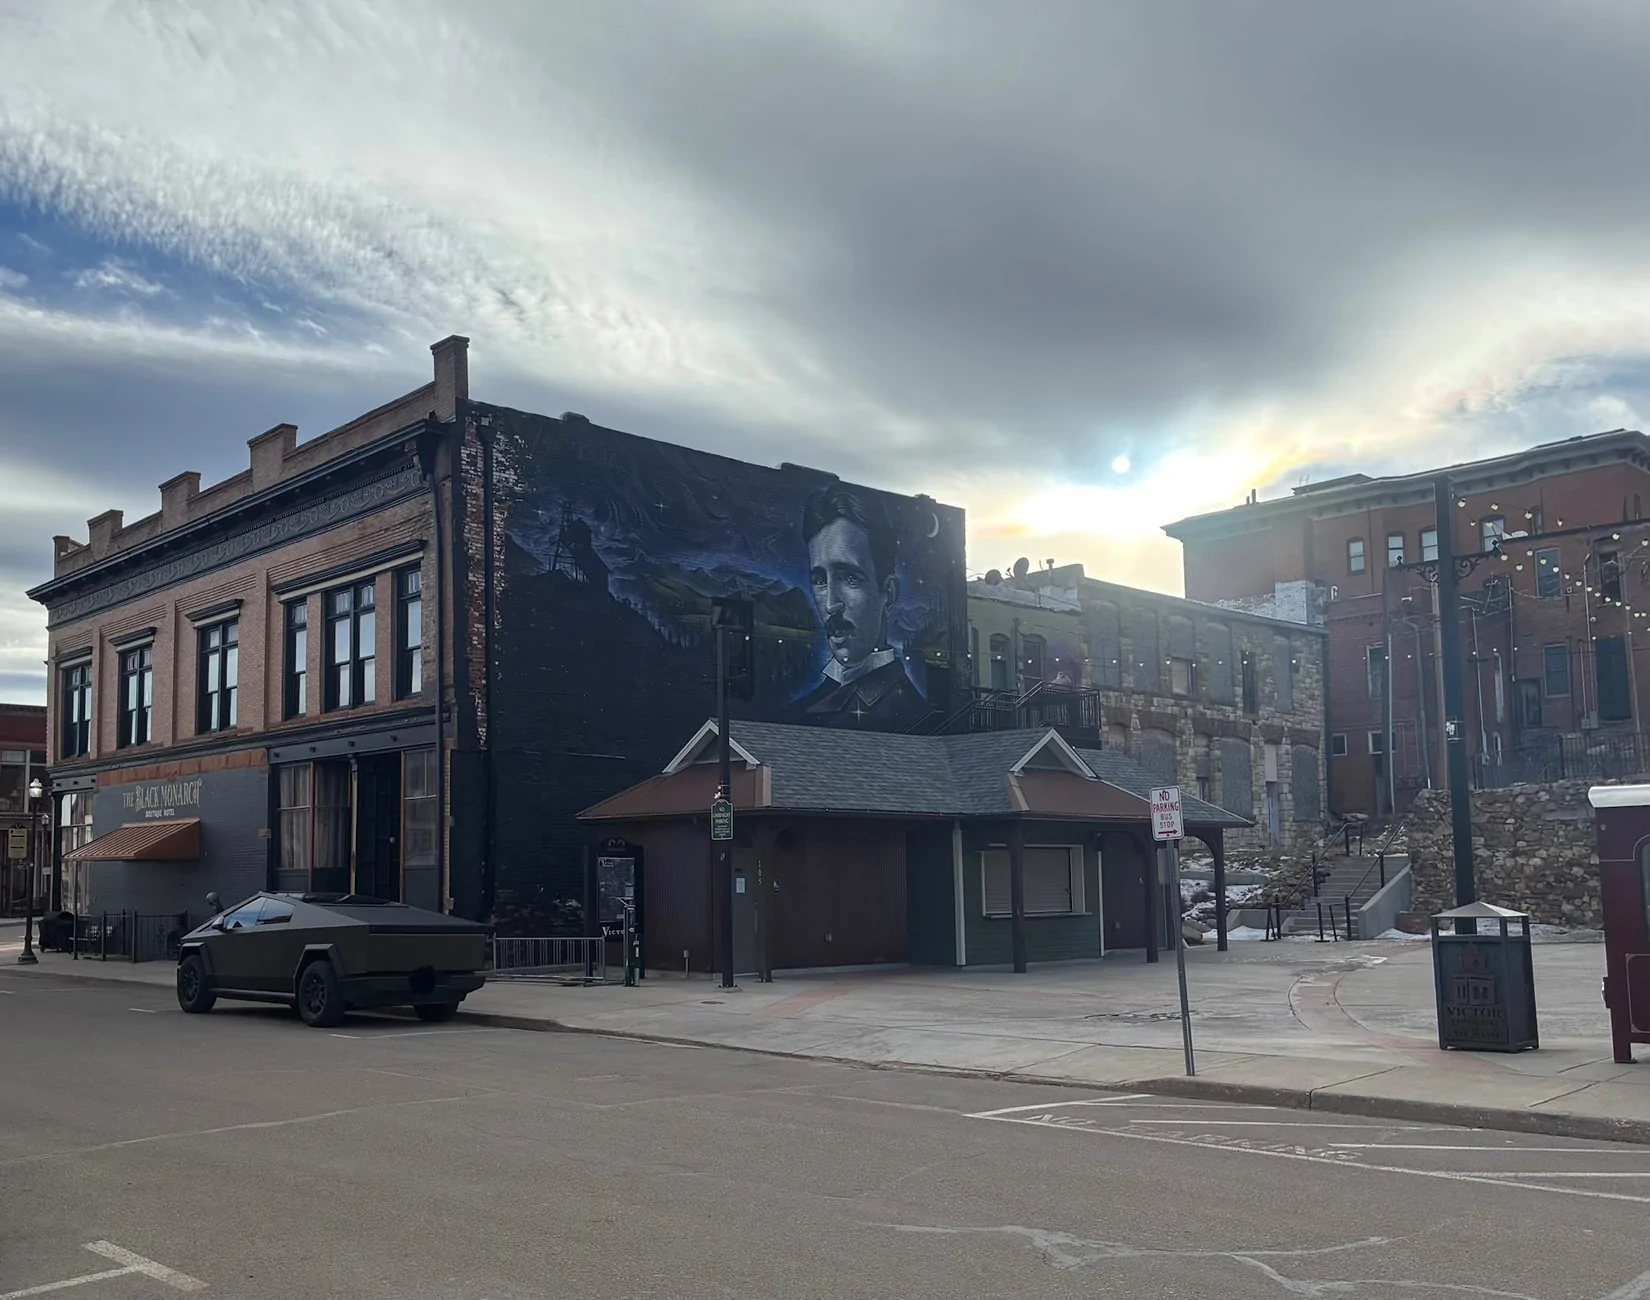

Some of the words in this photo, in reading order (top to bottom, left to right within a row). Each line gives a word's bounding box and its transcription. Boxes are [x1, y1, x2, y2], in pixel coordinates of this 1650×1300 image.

[122, 792, 134, 808] THE
[135, 785, 160, 812] BLACK
[161, 778, 203, 807] MONARCH
[1159, 791, 1170, 801] NO
[1152, 801, 1179, 813] PARKING
[1160, 821, 1175, 829] STOP
[602, 926, 625, 938] VICTO
[1447, 1006, 1502, 1019] VICTOR
